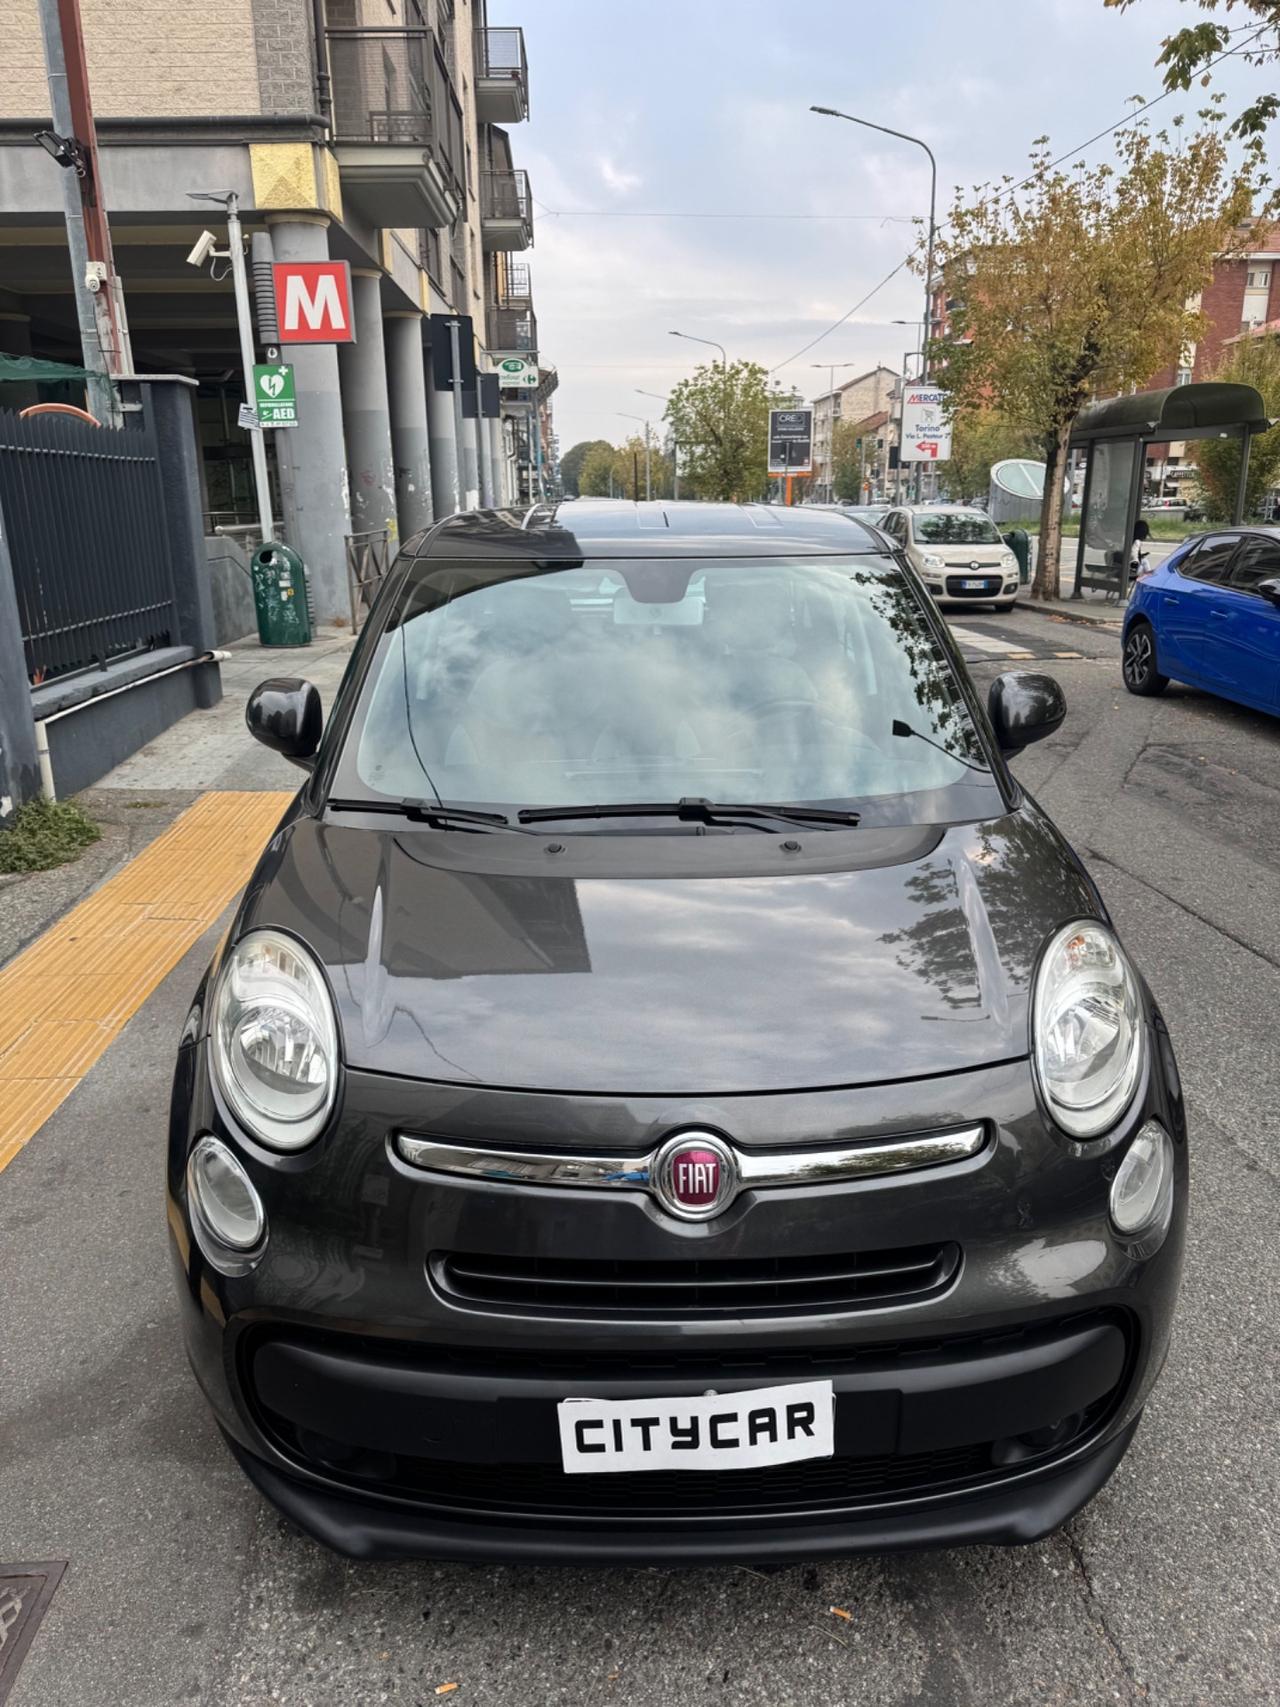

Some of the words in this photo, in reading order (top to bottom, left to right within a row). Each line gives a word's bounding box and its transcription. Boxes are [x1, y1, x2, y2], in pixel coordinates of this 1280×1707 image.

[284, 275, 346, 330] M
[272, 407, 296, 420] AED
[915, 424, 940, 432] Torino
[678, 1163, 716, 1194] FIAT
[574, 1401, 815, 1453] CITYCAR
